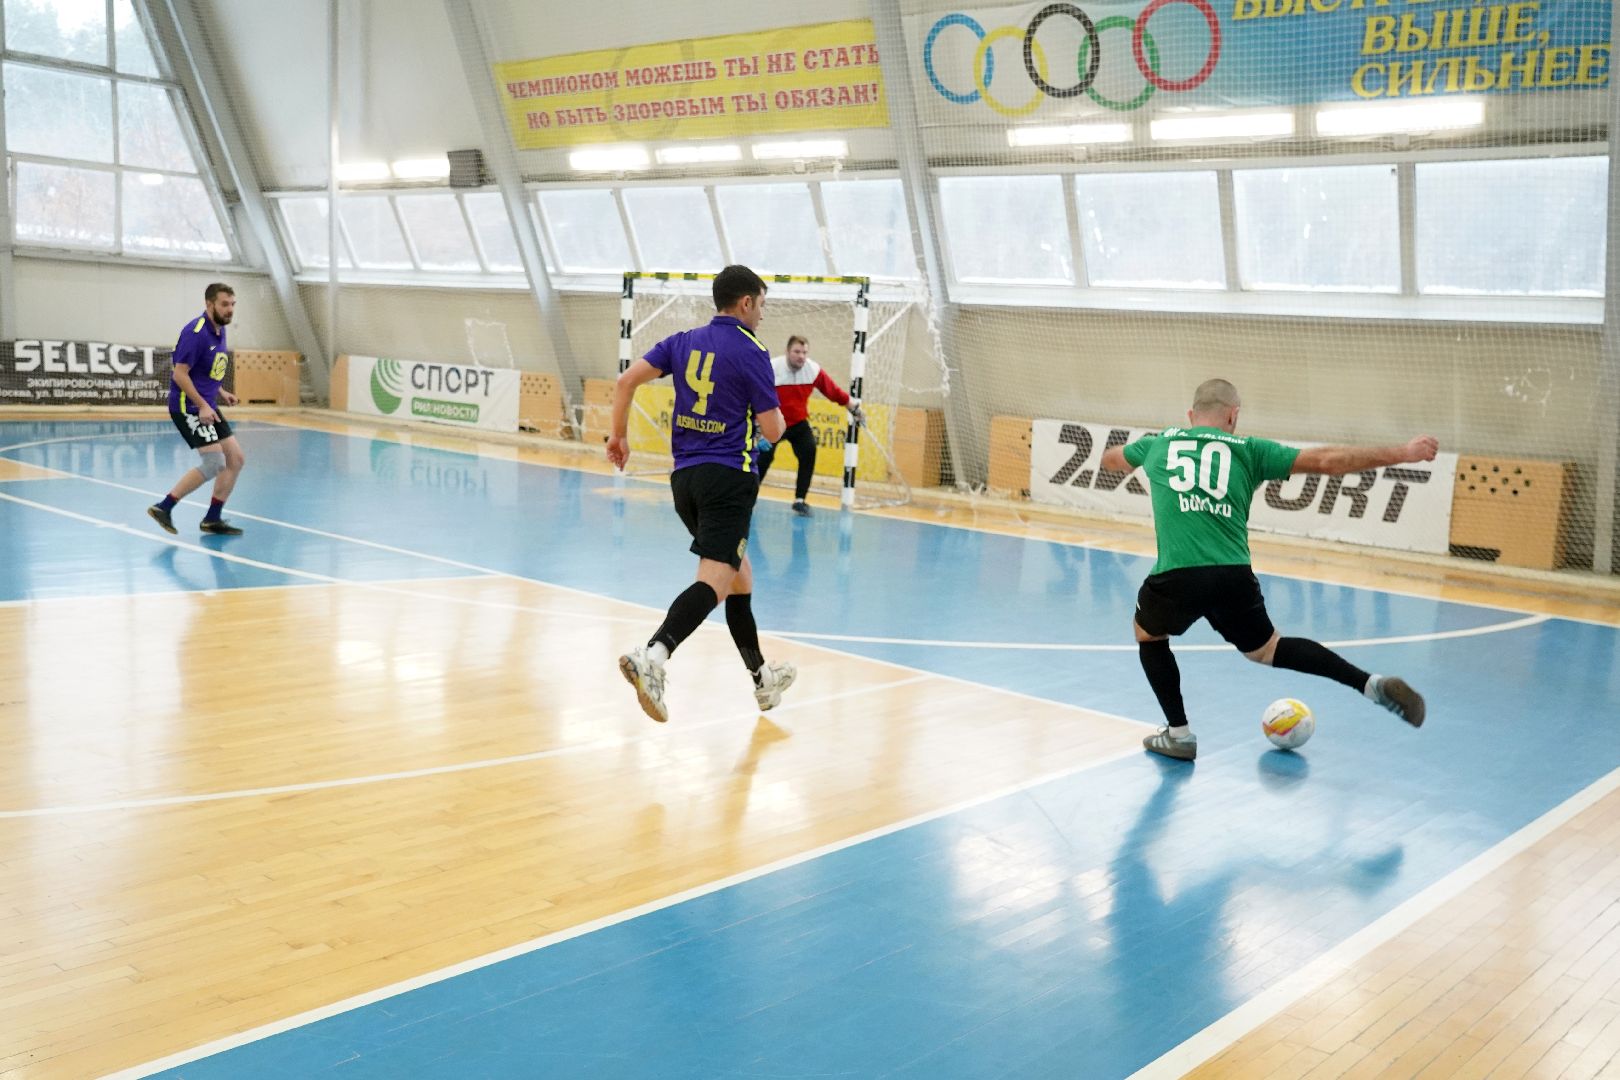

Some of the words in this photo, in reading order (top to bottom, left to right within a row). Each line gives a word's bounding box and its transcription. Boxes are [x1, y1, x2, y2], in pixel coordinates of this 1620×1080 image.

[1360, 2, 1549, 55] ВЫШЕ,
[507, 71, 620, 98] ЧЕМПИОНОМ
[625, 61, 717, 87] МОЖЕШЬ
[724, 56, 759, 77] ТЫ
[767, 52, 796, 73] НЕ
[804, 44, 879, 70] СТАТЬ
[1351, 44, 1612, 98] СИЛЬНЕЕ
[527, 111, 551, 129] НО
[555, 107, 607, 126] БЫТЬ
[614, 97, 725, 121] ЗДОРОВЫМ
[732, 93, 768, 113] ТЫ
[775, 83, 879, 109] ОБЯЗАН!
[14, 340, 156, 374] SELECT
[411, 364, 494, 396] СПОРТ
[0, 388, 34, 398] осква,
[27, 378, 125, 389] ЭКИПИРОВОЧНЫЙ
[685, 350, 715, 416] 4
[433, 404, 479, 418] НОВОСТИ
[1166, 440, 1232, 500] 50
